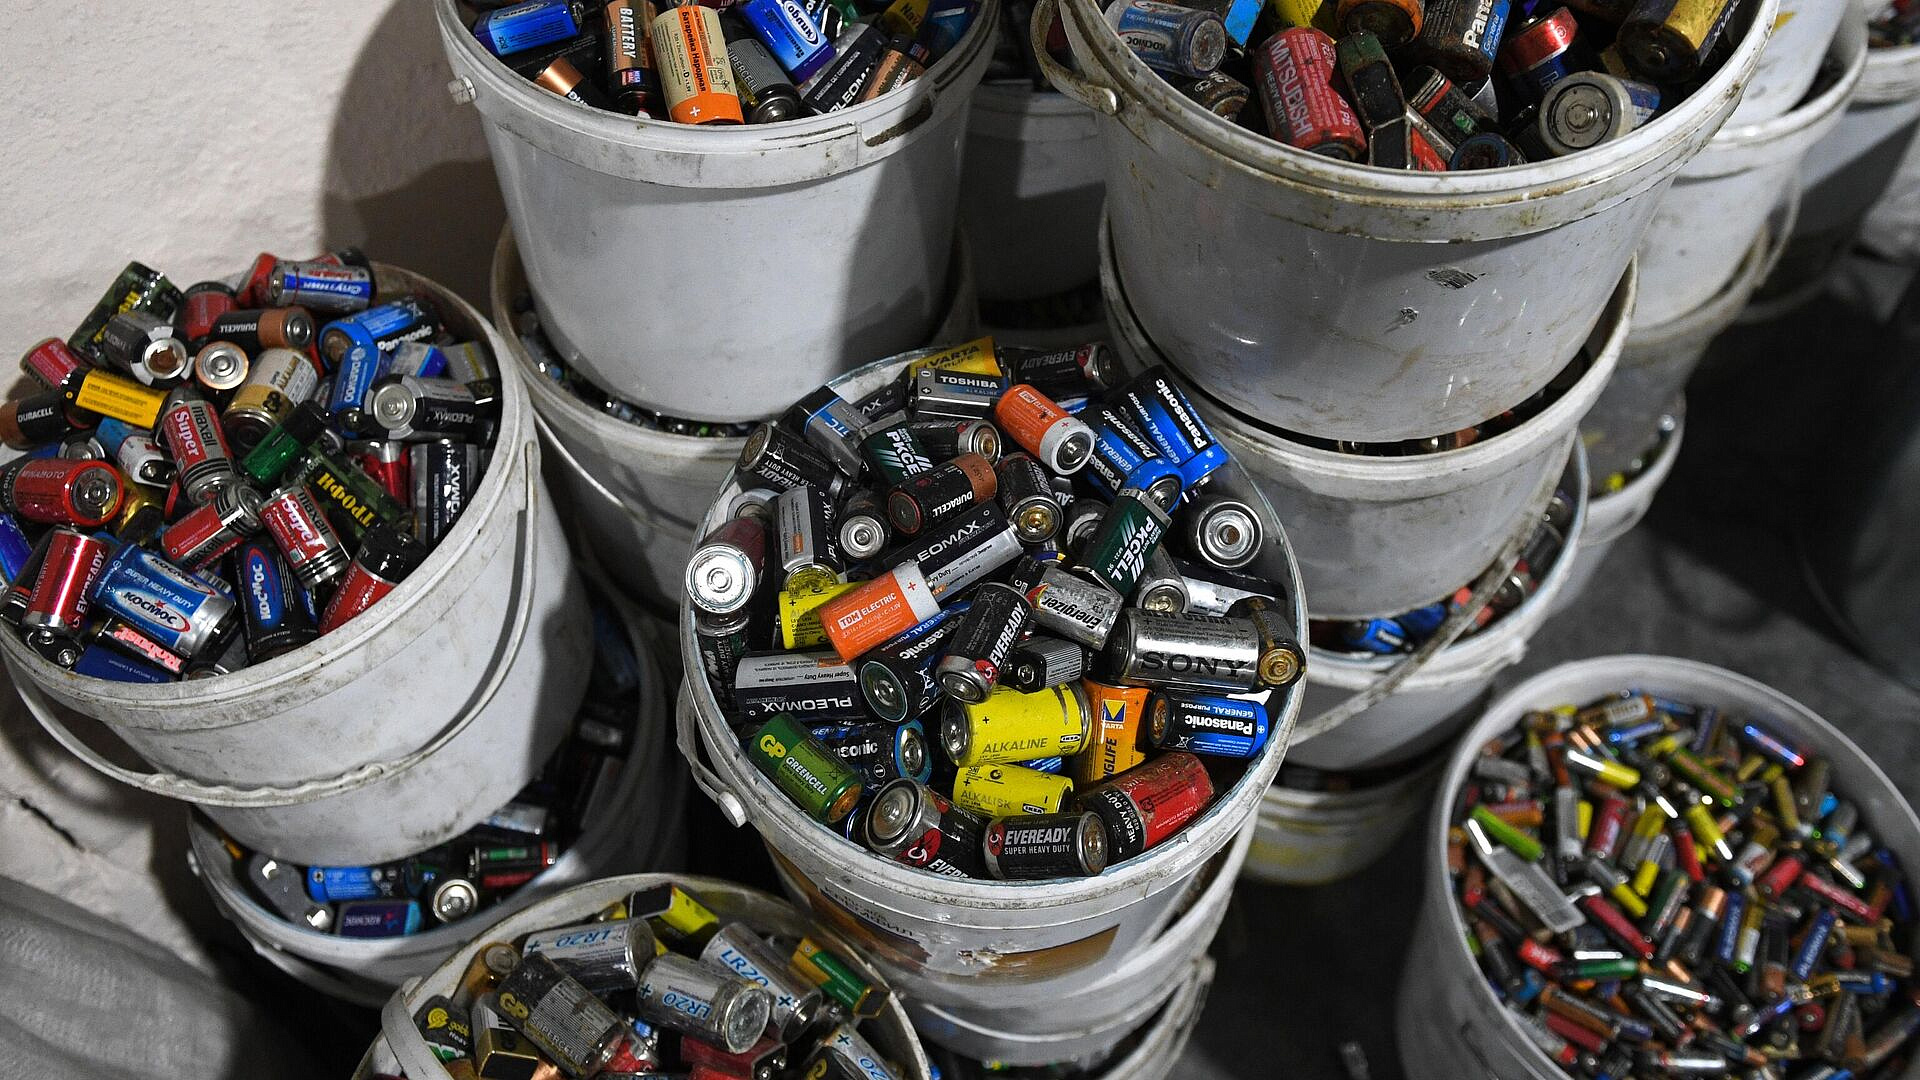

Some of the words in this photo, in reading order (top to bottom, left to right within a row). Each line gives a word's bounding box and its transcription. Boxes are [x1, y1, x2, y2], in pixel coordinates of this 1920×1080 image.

[620, 7, 636, 59] BATTERY
[682, 11, 697, 53] Батарейка
[692, 52, 706, 92] Народная
[726, 47, 758, 92] SUPERCELL
[1266, 70, 1280, 98] HEAVY
[1275, 99, 1287, 123] DUTY
[1270, 38, 1314, 137] MITSUBISHI
[219, 322, 257, 333] DURACELL
[928, 345, 980, 367] VARTA
[1020, 350, 1077, 370] EVEREADY
[940, 375, 999, 389] TOSHIBA
[17, 406, 54, 423] DURACELL
[1127, 391, 1152, 422] PURPOSE
[1155, 378, 1208, 450] Panasonic
[174, 410, 200, 456] Super
[191, 405, 217, 447] maxell
[1102, 409, 1157, 458] Panasonic
[885, 430, 922, 476] PKCE
[1100, 440, 1133, 472] GENERAL
[1149, 422, 1180, 464] GENERAL
[764, 460, 781, 472] DUTY
[781, 468, 801, 481] HEAVY
[1089, 453, 1122, 492] Panas
[298, 491, 330, 538] maxell
[316, 471, 378, 528] ТРОФИ
[932, 489, 974, 517] DURACELL
[281, 497, 323, 549] Super
[183, 537, 226, 567] maxell
[1110, 515, 1155, 581] PKCELL
[124, 566, 150, 584] SUPER
[149, 577, 175, 600] HEAVY
[173, 590, 196, 610] DUTY
[150, 557, 202, 589] КОСМОС
[939, 567, 953, 581] Duty
[1014, 579, 1023, 588] C
[123, 589, 178, 625] КОСМОС
[252, 563, 272, 621] КОСМОС
[839, 611, 861, 628] TDM
[862, 593, 897, 616] ELECTRIC
[1042, 595, 1103, 632] Energizer
[114, 627, 184, 672] Robust
[899, 613, 966, 659] Panasonic
[990, 600, 1027, 670] EVEREADY.
[803, 673, 817, 682] Duty
[818, 672, 835, 681] Heavy
[836, 671, 850, 680] Super
[1141, 652, 1248, 678] SONY
[763, 696, 853, 714] PLEOMAX
[1180, 702, 1211, 711] PURPOSE
[1216, 707, 1255, 718] GENERAL
[1101, 722, 1125, 731] VARTA
[1184, 714, 1253, 735] Panasonic
[759, 733, 787, 760] GP
[982, 737, 1049, 755] ALKALINE
[785, 755, 829, 796] GREENCELL
[960, 790, 1011, 810] ALKALISK
[1023, 804, 1043, 814] IKEA
[1103, 790, 1125, 812] DUTY
[1004, 827, 1072, 846] EVEREADY.
[1119, 810, 1136, 843] HEAVY
[1004, 846, 1026, 855] SUPER
[1028, 845, 1051, 854] HEAVY
[1052, 844, 1071, 853] DUTY
[555, 928, 613, 949] LR20
[719, 949, 769, 987] LR20
[499, 992, 529, 1020] GP
[662, 992, 713, 1021] LR20
[530, 1016, 583, 1062] SUPERCELL
